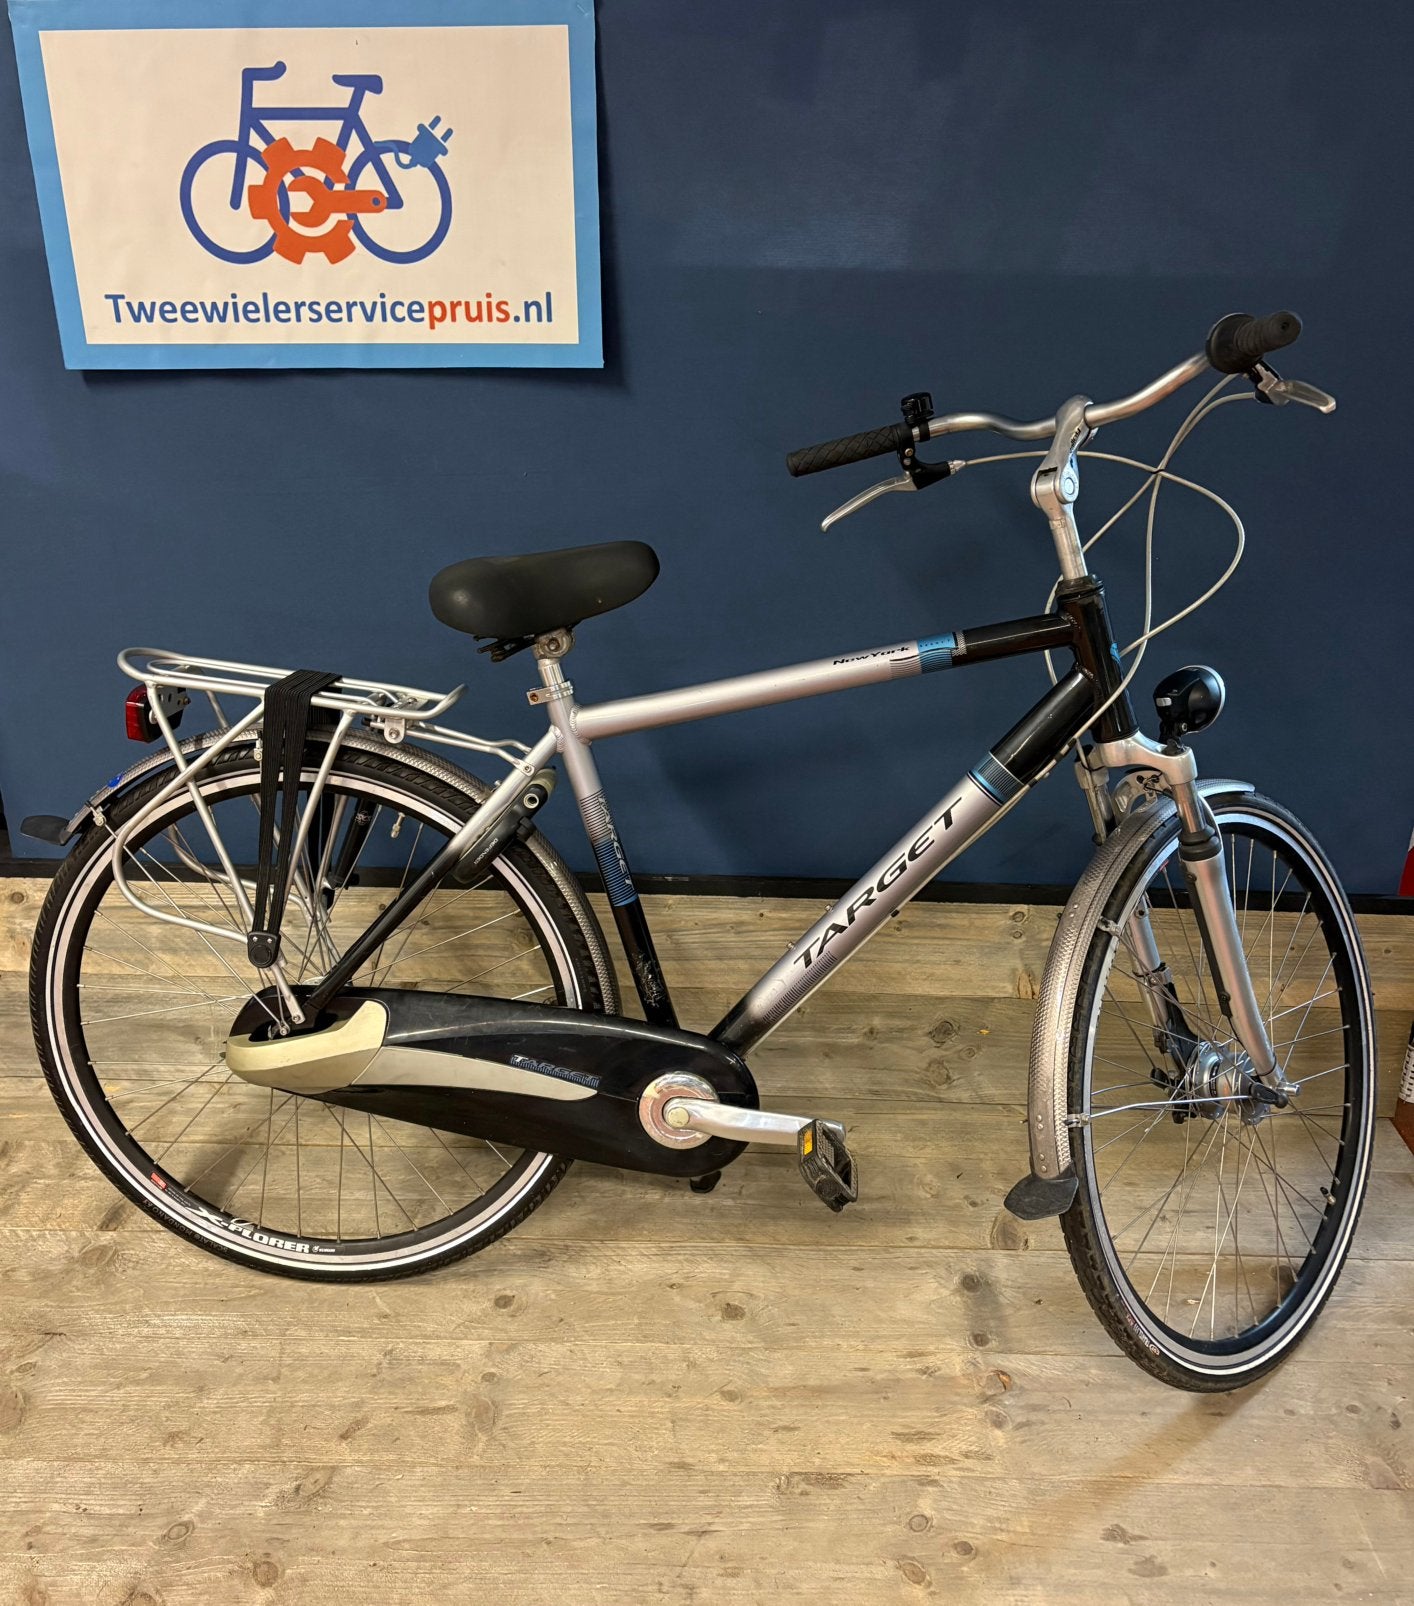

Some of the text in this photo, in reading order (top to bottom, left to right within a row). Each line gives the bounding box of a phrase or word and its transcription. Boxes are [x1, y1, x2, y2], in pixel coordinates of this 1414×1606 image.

[105, 291, 553, 330] Tweewielerservicepruis.nl
[598, 796, 634, 891] TARGET
[793, 797, 962, 969] TARGET
[512, 1054, 602, 1082] TARGET
[186, 1207, 310, 1254] X-PLORER
